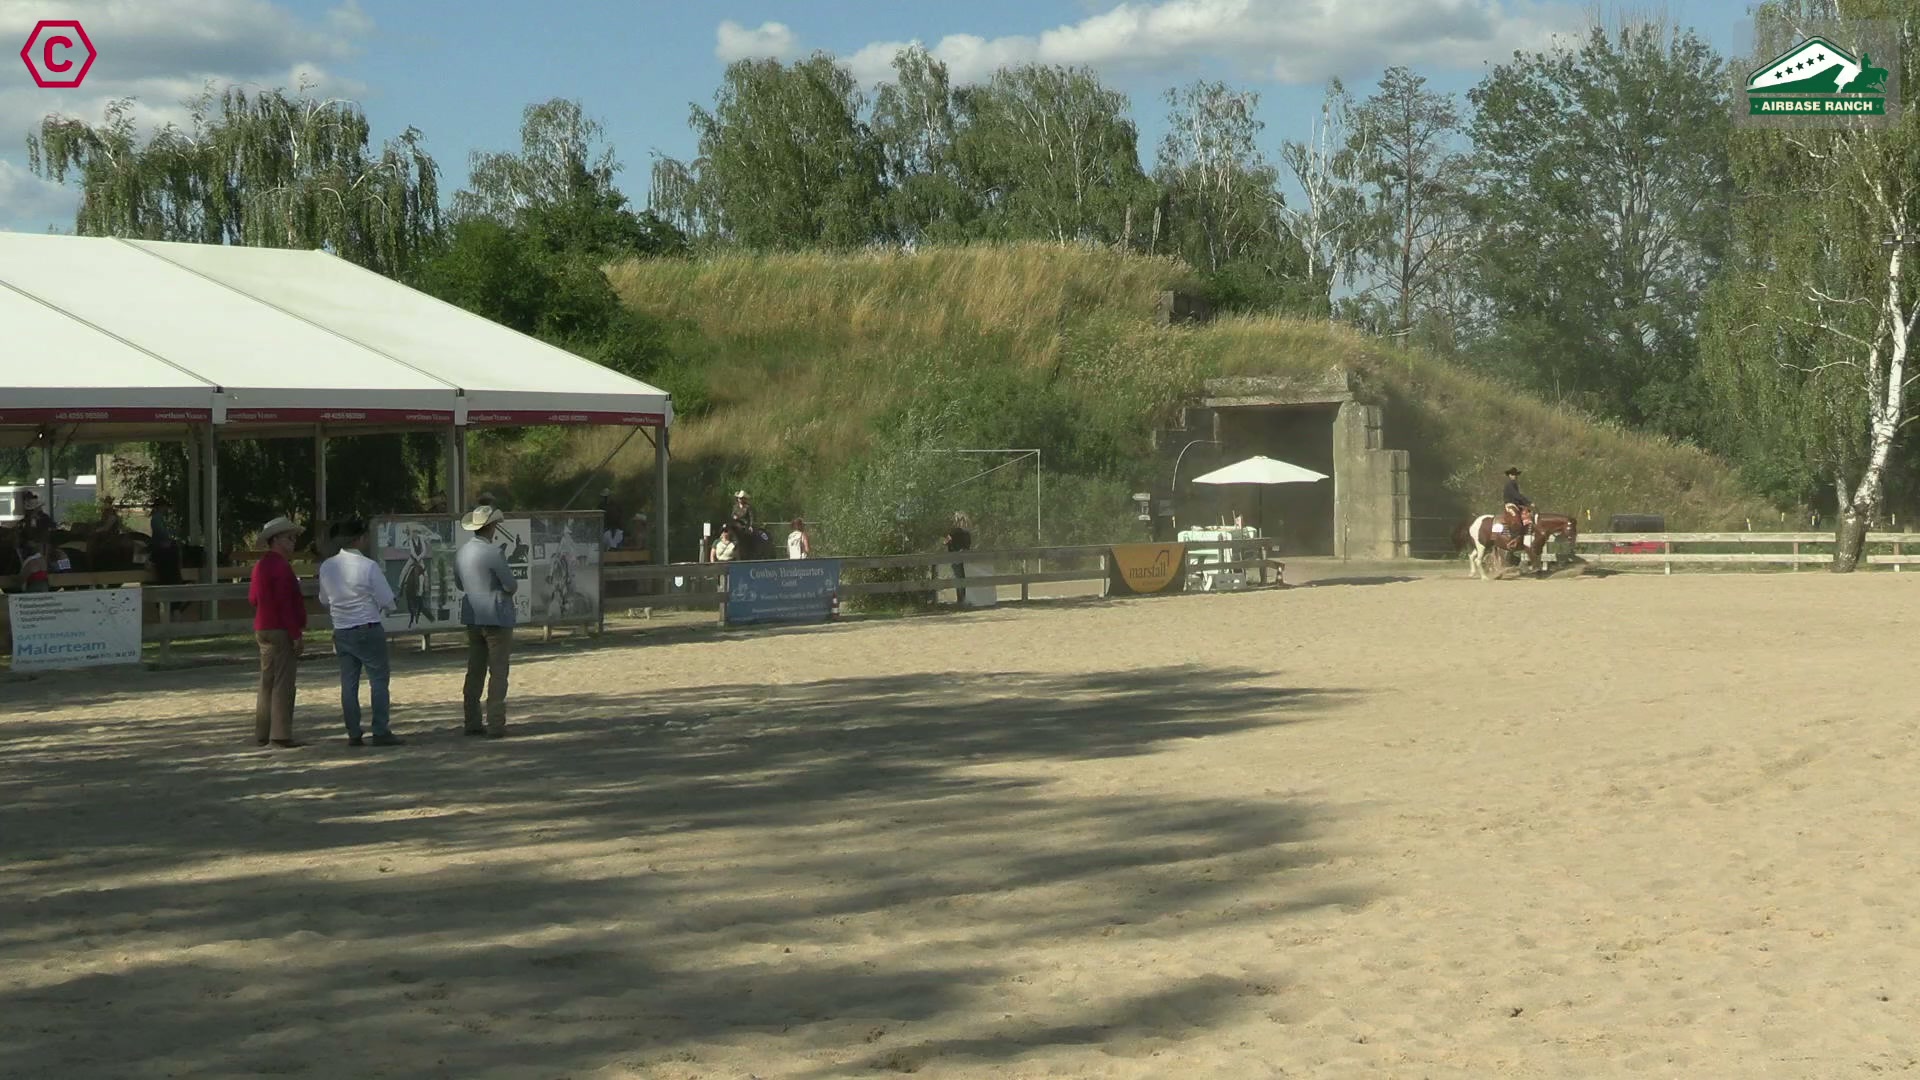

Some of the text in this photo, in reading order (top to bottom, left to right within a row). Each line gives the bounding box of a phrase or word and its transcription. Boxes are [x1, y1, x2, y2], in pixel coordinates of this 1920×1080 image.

[750, 567, 824, 581] Cowboy Headquarters
[1129, 561, 1166, 578] marstall
[17, 642, 106, 657] Malerteam
